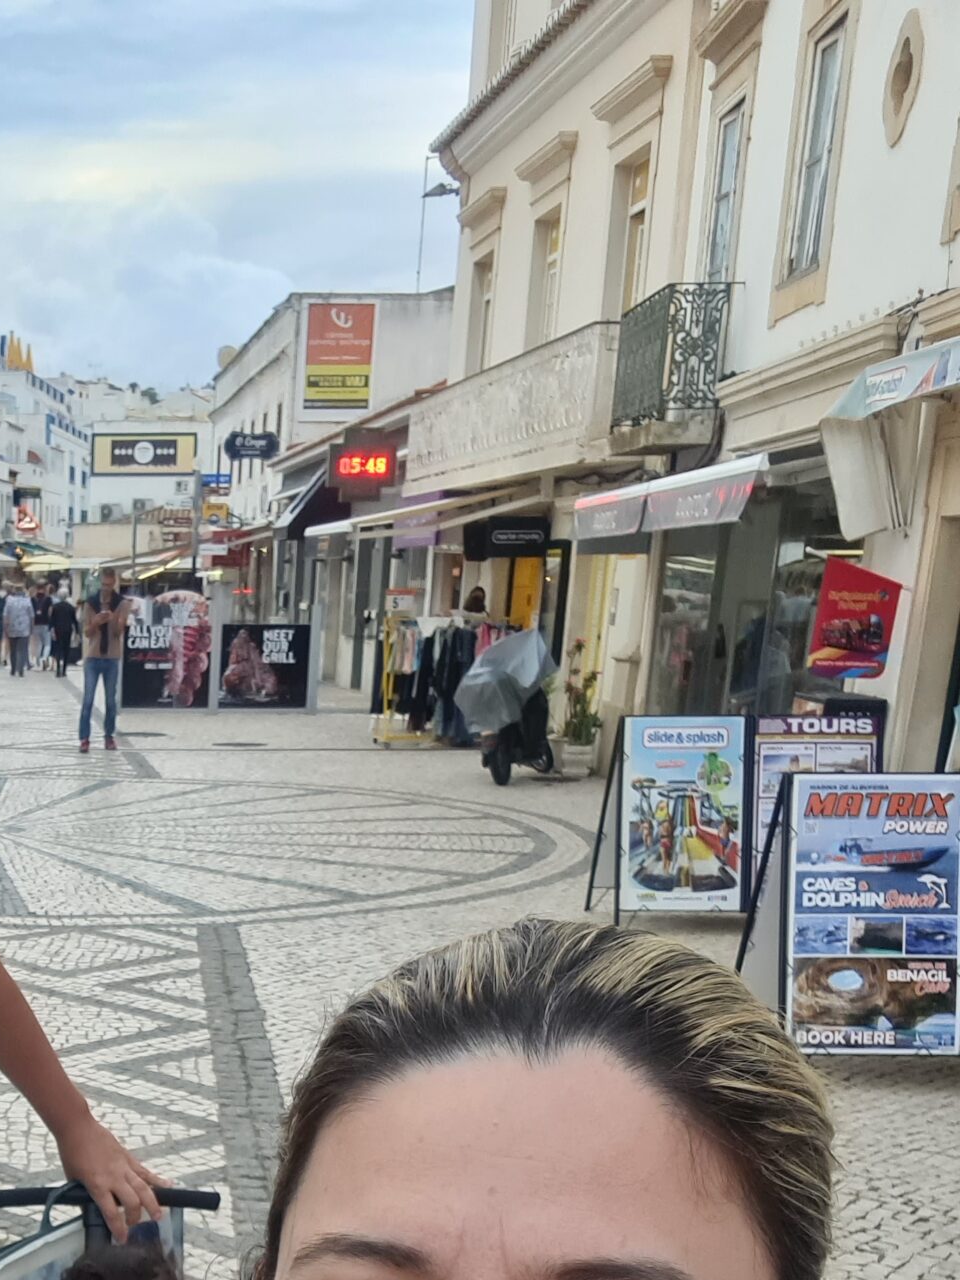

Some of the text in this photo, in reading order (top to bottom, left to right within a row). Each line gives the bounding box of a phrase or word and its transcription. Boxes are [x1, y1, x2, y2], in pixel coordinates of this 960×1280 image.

[128, 625, 149, 637] ALL
[262, 629, 295, 641] MEET
[127, 637, 150, 649] CAN
[262, 640, 289, 652] OUR
[262, 651, 296, 663] GRILL
[787, 718, 873, 733] TOURS
[647, 731, 724, 746] slide & splash
[804, 792, 955, 817] MATRIX
[882, 820, 948, 834] POWER
[802, 877, 856, 892] CAVES
[802, 891, 885, 907] DOLPHIN
[887, 969, 951, 982] BENAGIL
[796, 1030, 896, 1045] BOOK HERE
